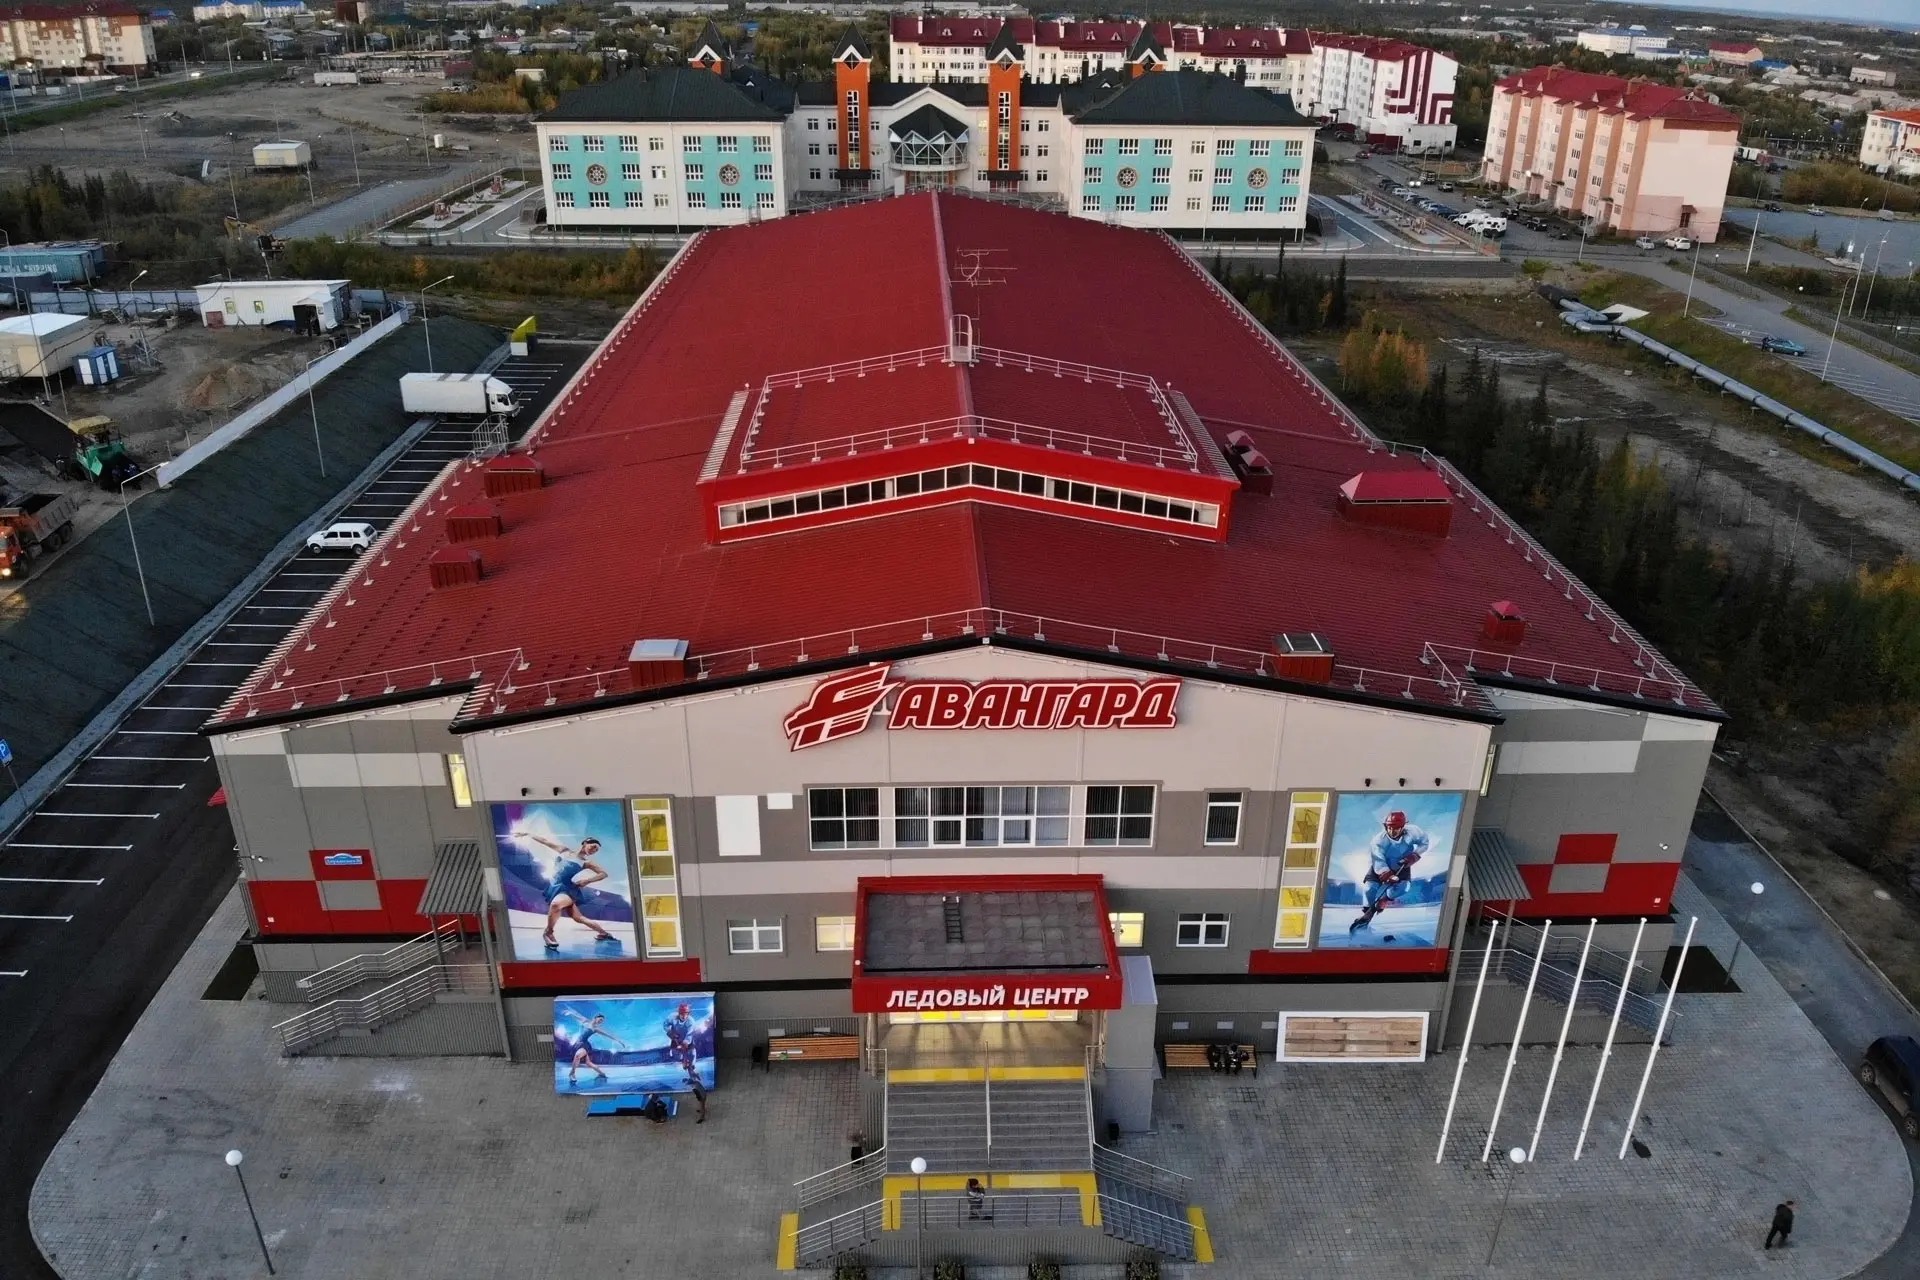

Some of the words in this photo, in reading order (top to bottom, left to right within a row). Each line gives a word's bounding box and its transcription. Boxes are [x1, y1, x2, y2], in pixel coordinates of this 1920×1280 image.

[888, 681, 1182, 730] АВАНГАРД
[886, 984, 1005, 1010] ЛЕДОВЫЙ
[1013, 987, 1090, 1008] ЦЕНТР
